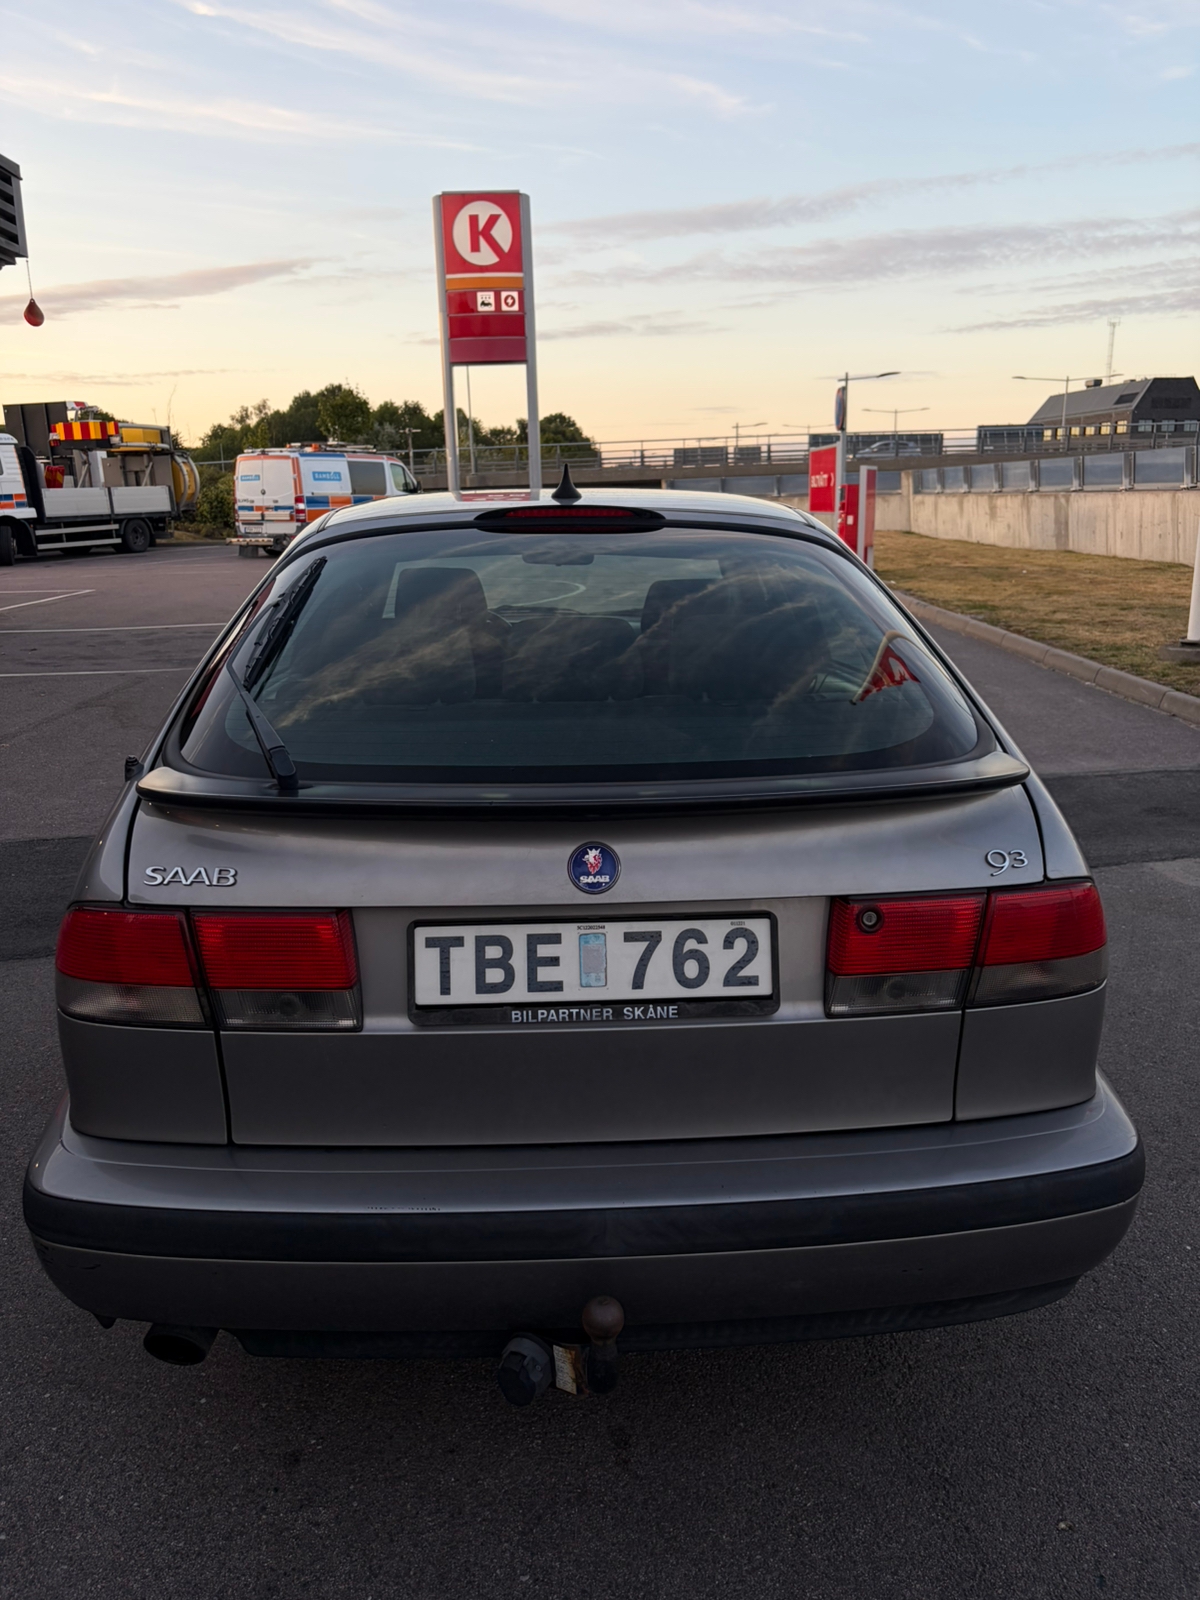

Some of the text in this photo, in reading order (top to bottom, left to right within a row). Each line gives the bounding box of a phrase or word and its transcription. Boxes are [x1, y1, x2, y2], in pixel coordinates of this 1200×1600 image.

[468, 214, 508, 261] K
[143, 866, 238, 887] SAAB
[579, 875, 610, 884] SAAB
[424, 927, 760, 996] TBE 762
[511, 1004, 679, 1024] BILPARTNER SKÅNE
